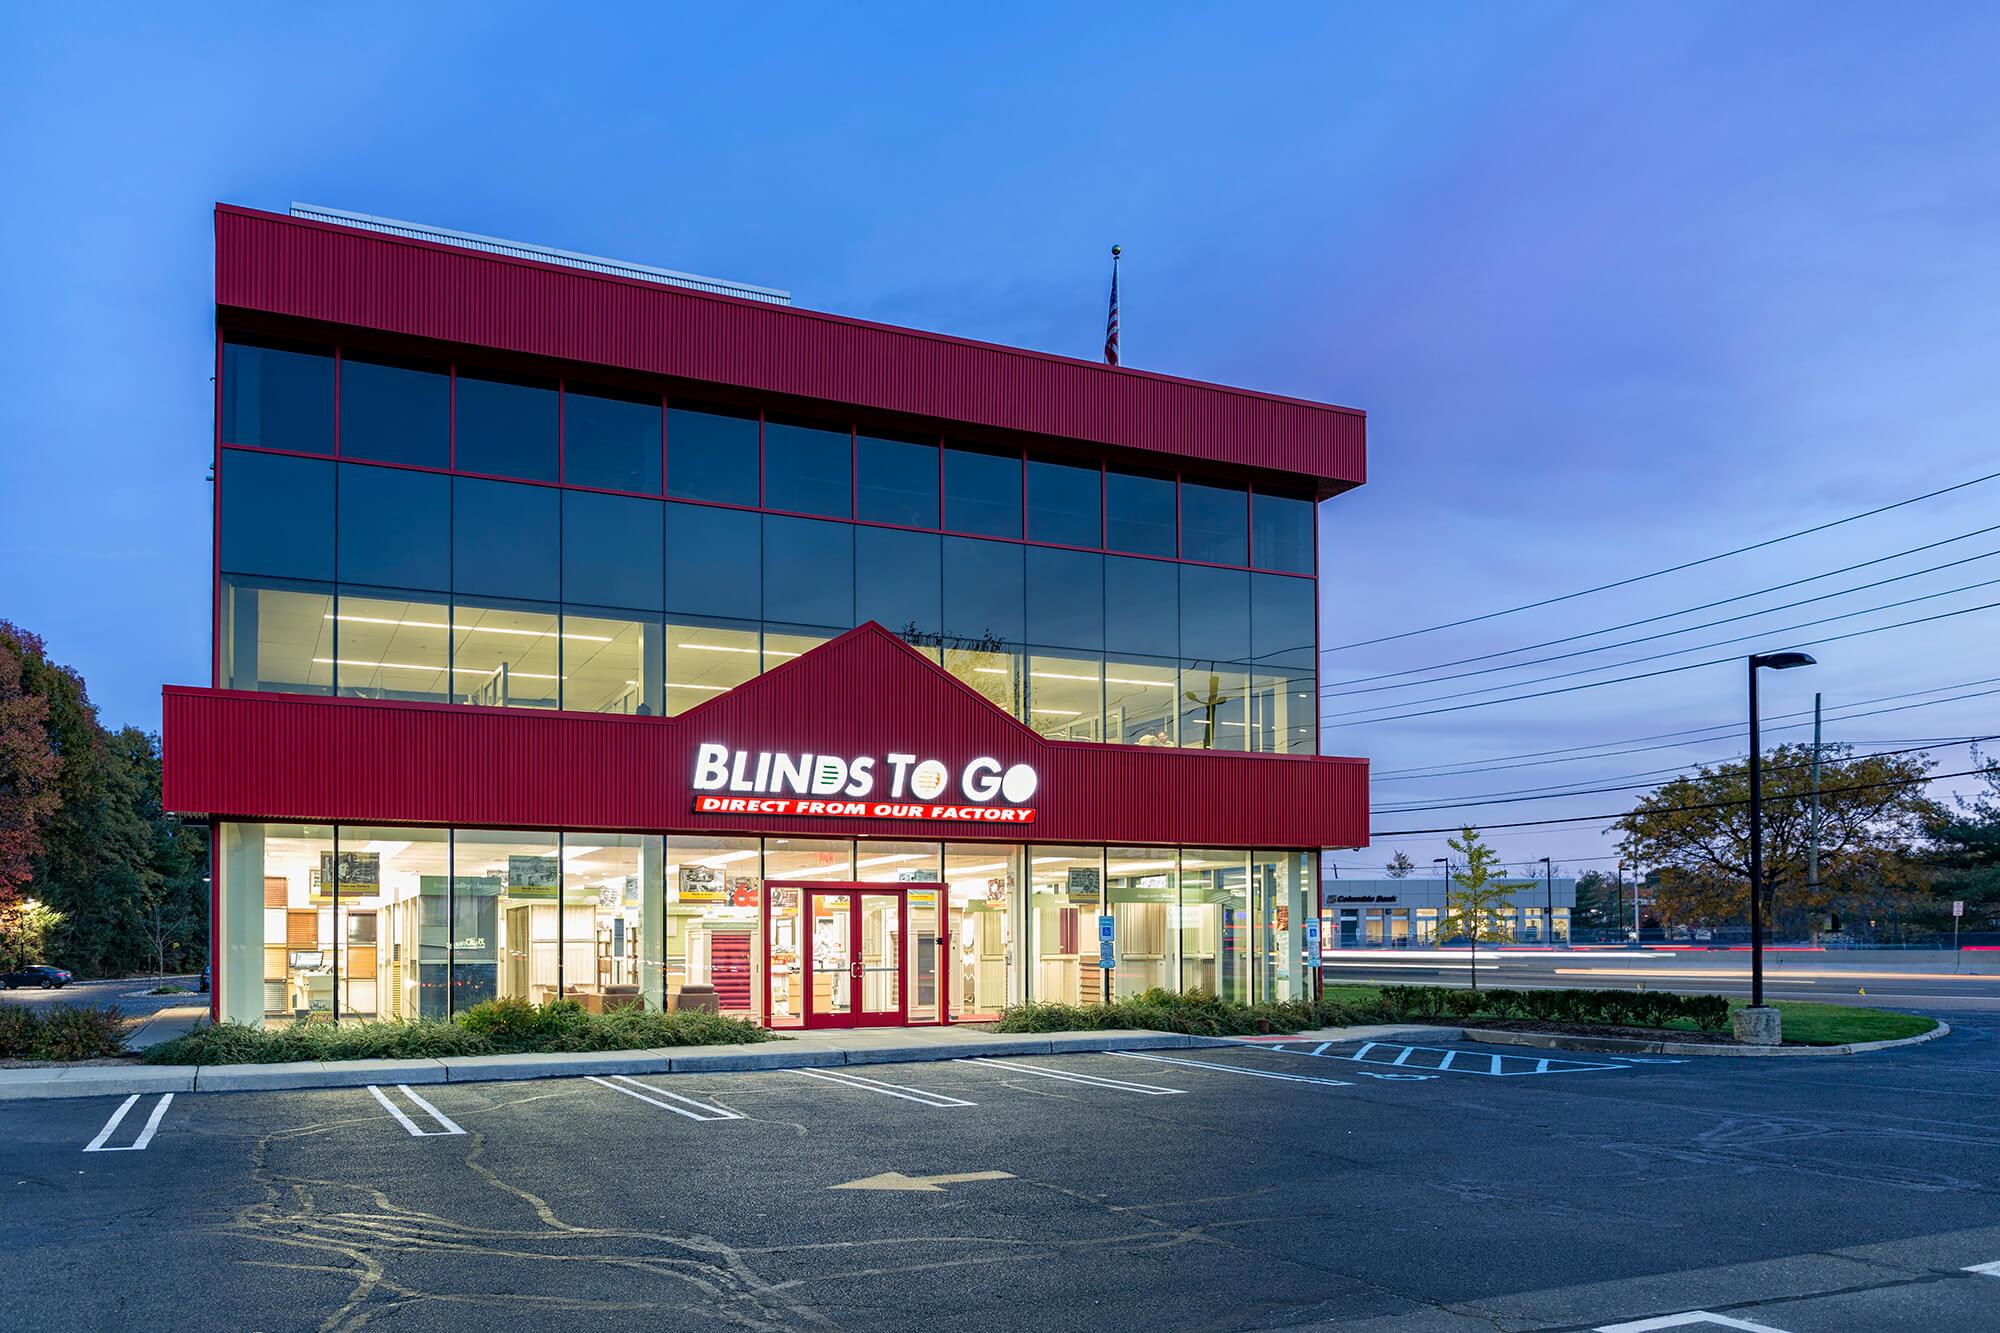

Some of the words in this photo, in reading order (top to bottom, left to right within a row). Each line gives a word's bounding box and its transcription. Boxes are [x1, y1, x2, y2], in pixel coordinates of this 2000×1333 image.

[693, 743, 875, 797] BLINDS
[887, 753, 948, 800] TO
[962, 757, 1038, 803] GO
[702, 798, 789, 812] DIRECT
[796, 802, 866, 816] FROM
[874, 805, 923, 818] OUR
[931, 807, 1032, 821] FACTORY
